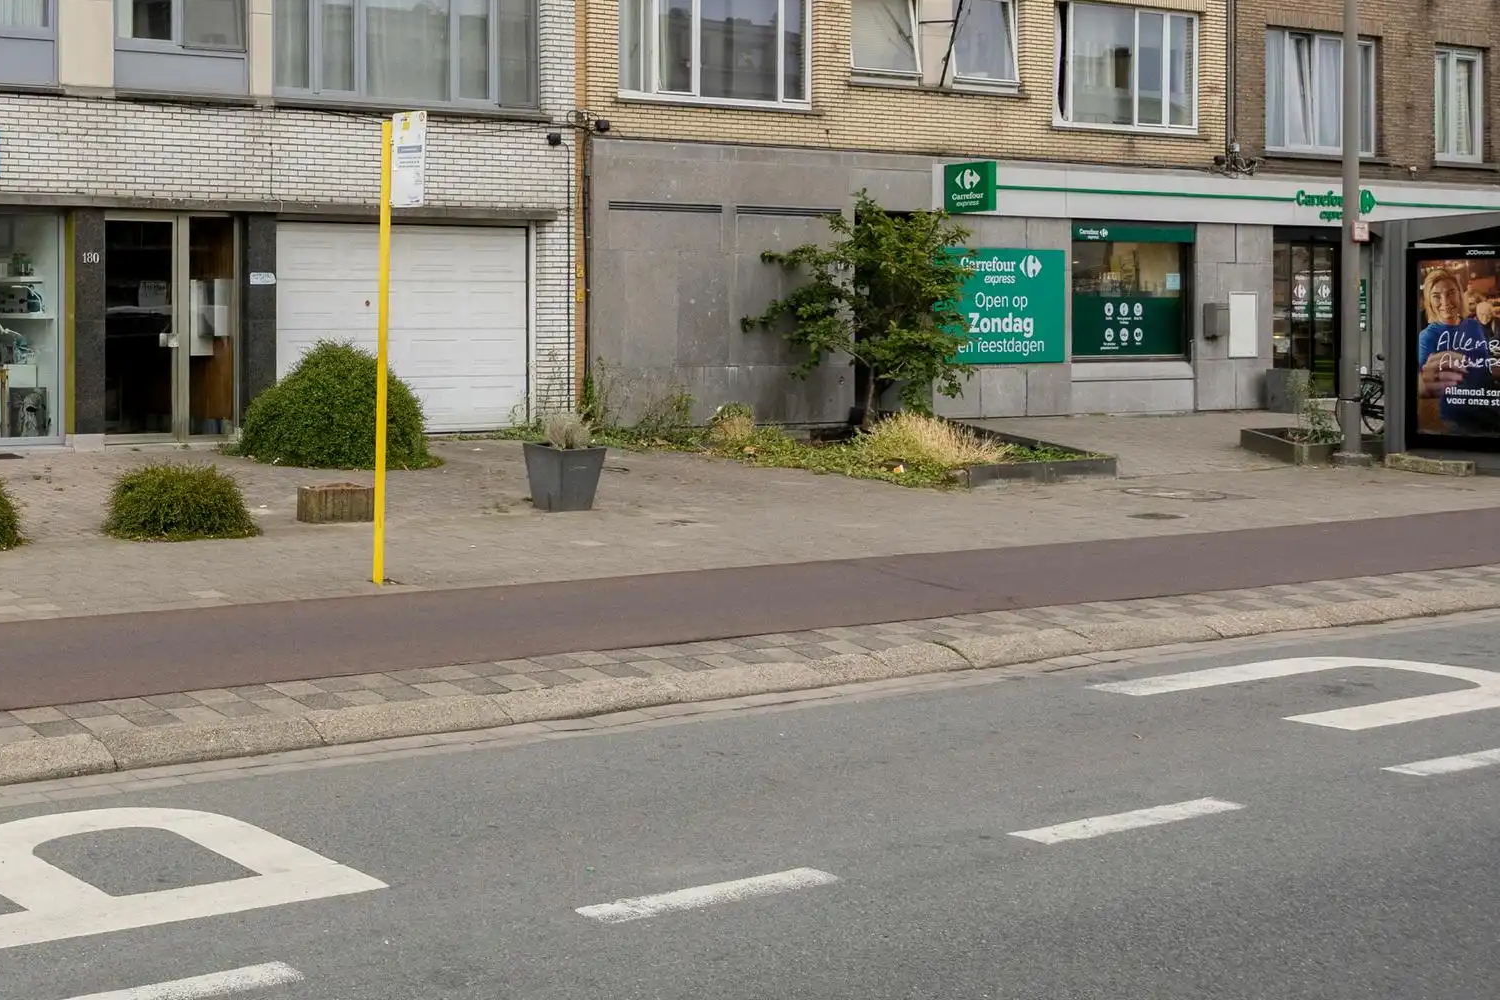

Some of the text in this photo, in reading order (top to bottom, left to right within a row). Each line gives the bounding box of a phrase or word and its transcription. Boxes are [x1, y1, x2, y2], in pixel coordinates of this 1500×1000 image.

[951, 192, 984, 200] Carrefour
[82, 252, 100, 264] 180
[960, 256, 1016, 272] Carrefour
[984, 275, 1016, 286] express
[975, 292, 1028, 311] Open op
[968, 312, 1034, 338] Zondag
[958, 341, 974, 353] en
[978, 337, 1045, 357] feestdagen
[1445, 386, 1485, 396] Allemaal
